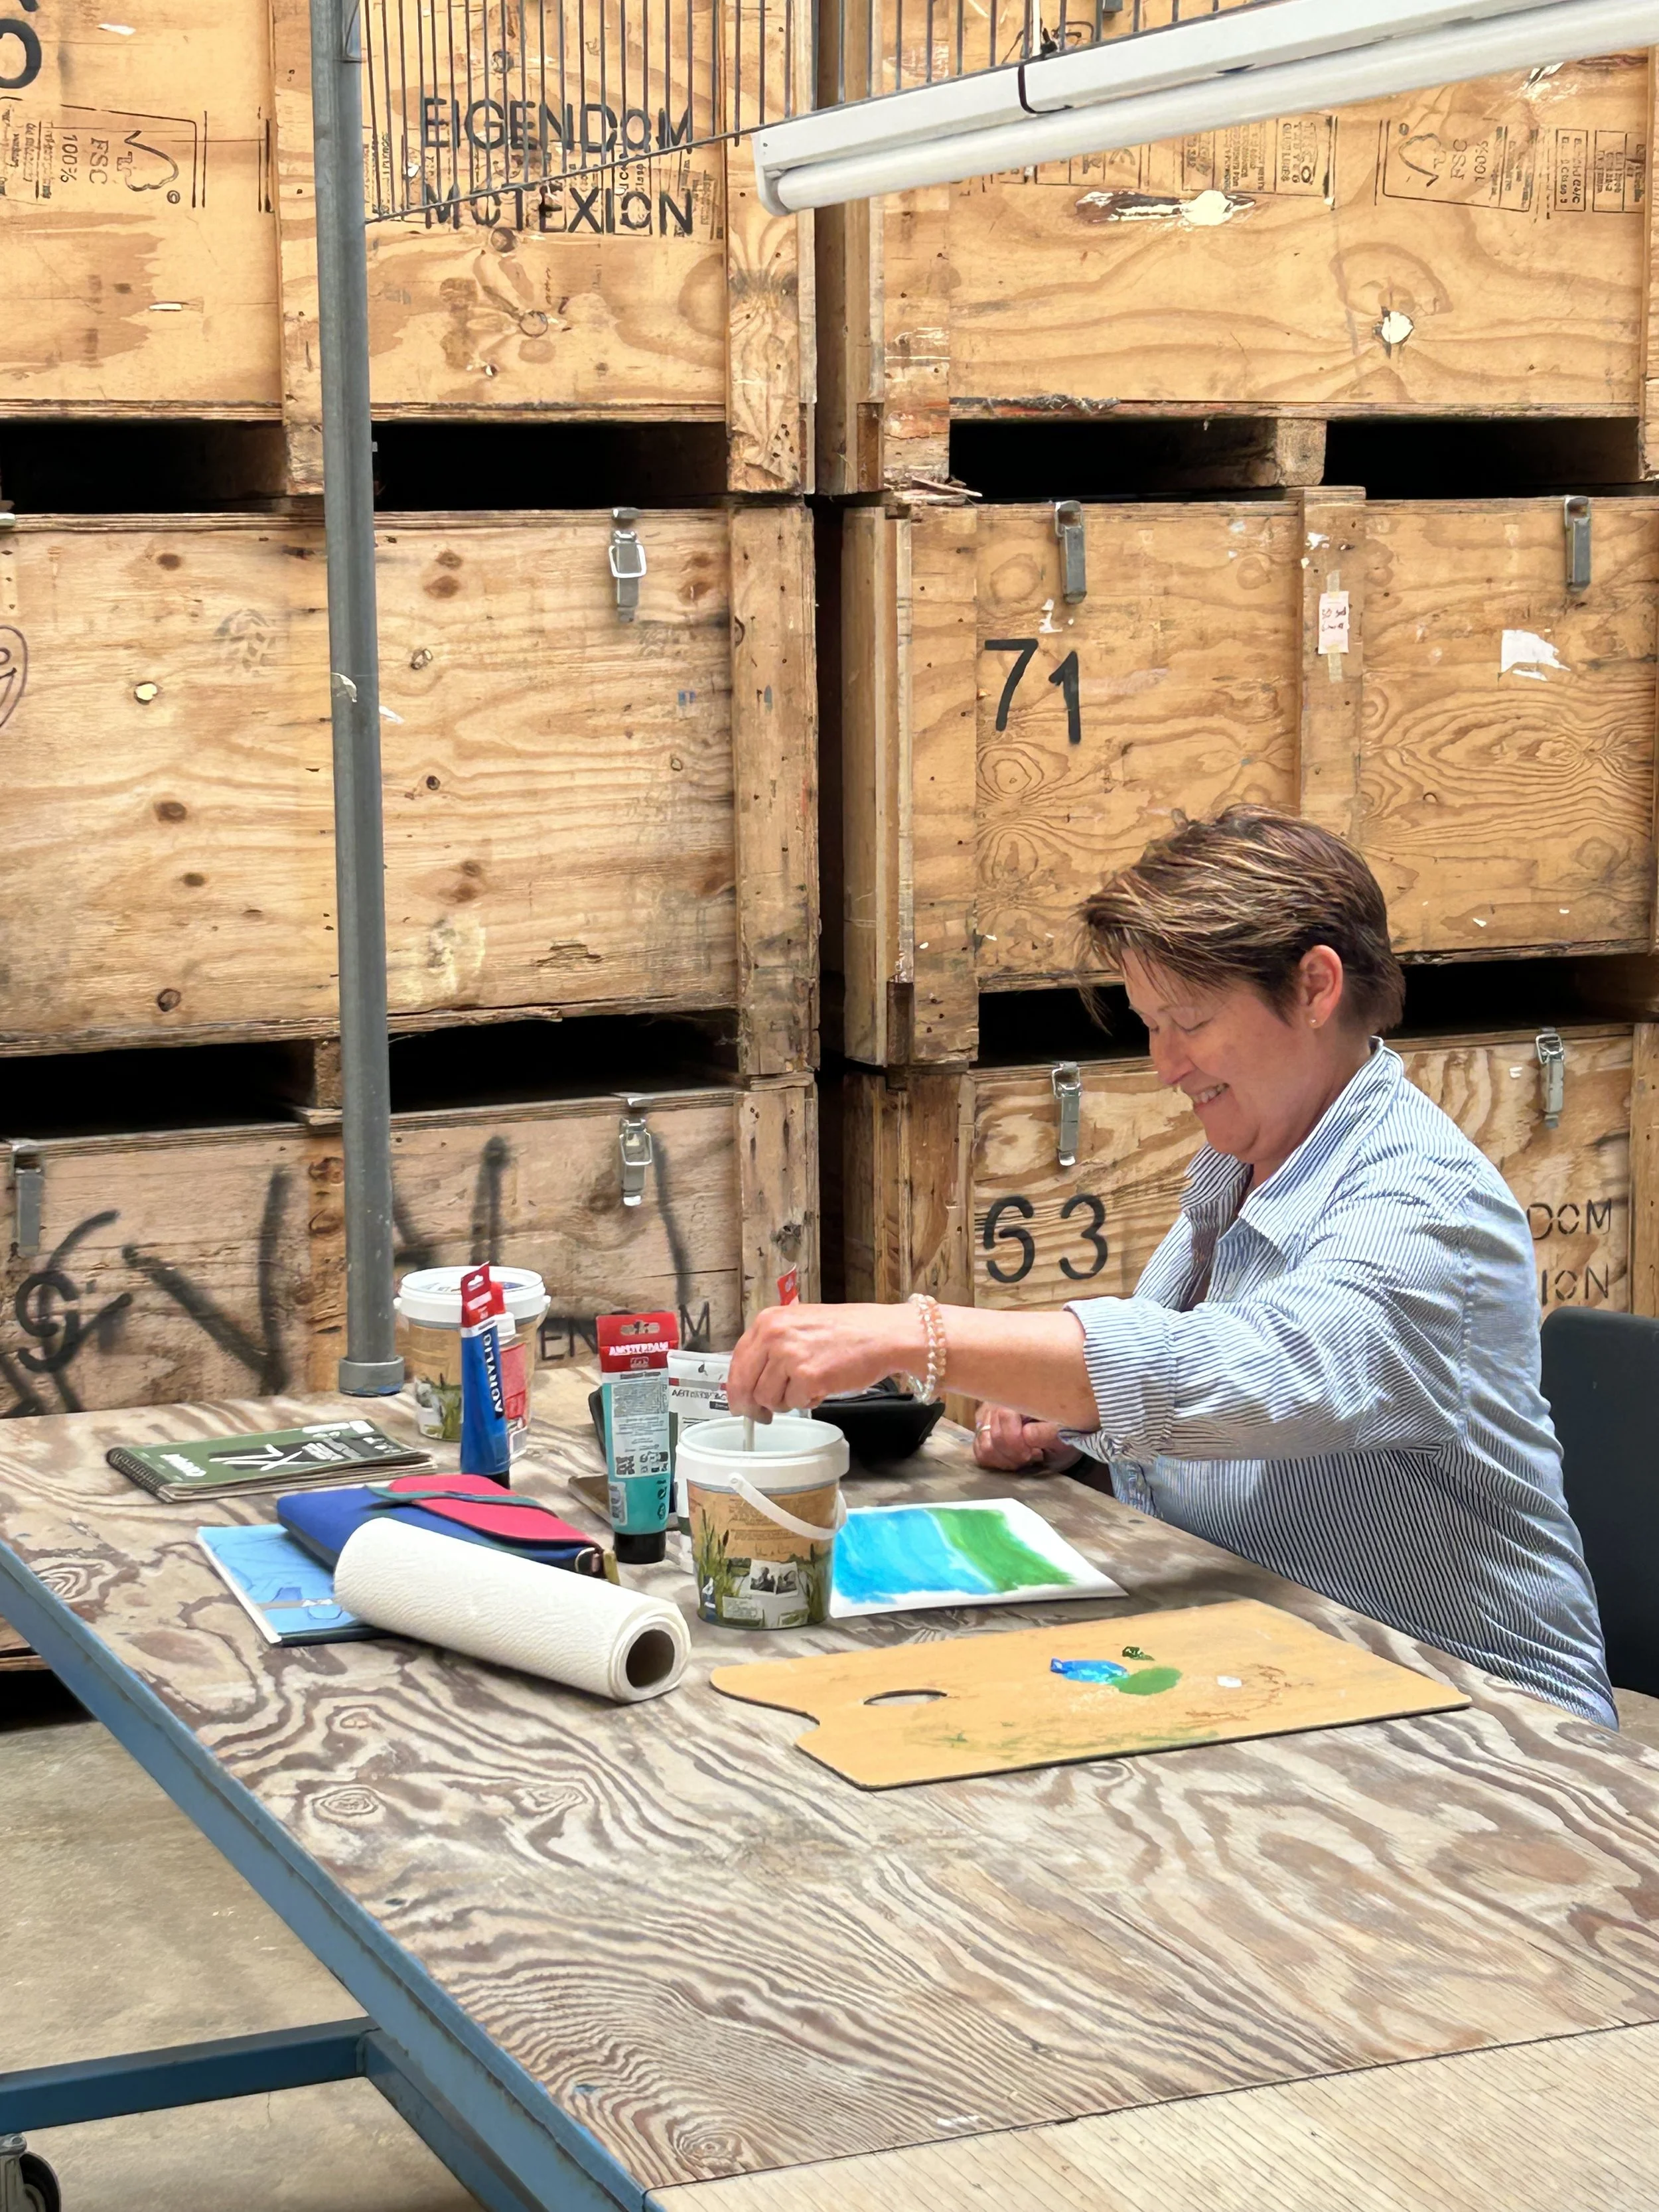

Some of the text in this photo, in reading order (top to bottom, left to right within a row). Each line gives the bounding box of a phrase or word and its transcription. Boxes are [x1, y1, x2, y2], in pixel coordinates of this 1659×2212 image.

[421, 98, 693, 154] EIGENDOM
[60, 134, 78, 183] 100%
[90, 139, 108, 184] FSC
[1449, 139, 1467, 180] FSC
[425, 182, 693, 236] MOTEXION
[985, 638, 1082, 745] 71
[983, 1195, 1108, 1284] 63
[1526, 1199, 1612, 1241] DOM
[1541, 1262, 1610, 1305] ION
[609, 1341, 670, 1356] AMSTERDAM
